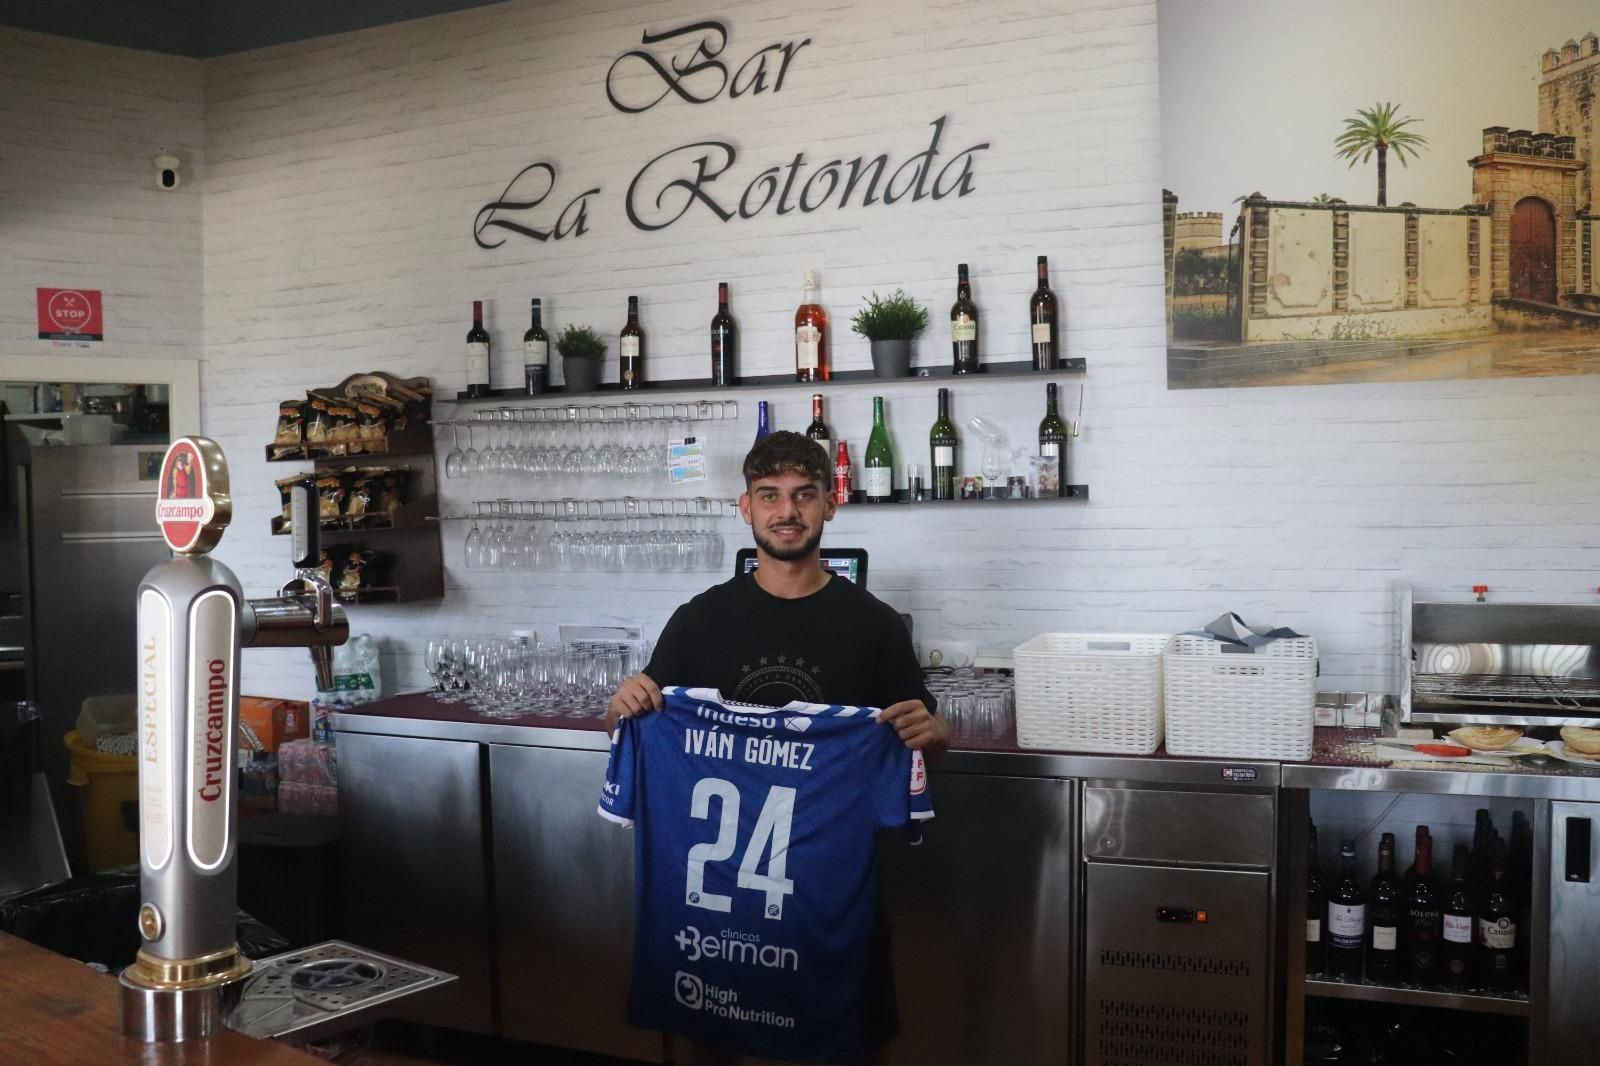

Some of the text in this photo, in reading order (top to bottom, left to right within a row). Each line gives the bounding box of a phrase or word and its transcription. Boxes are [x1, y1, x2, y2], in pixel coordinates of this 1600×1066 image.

[605, 20, 811, 114] Bar
[473, 115, 990, 249] La Rotonda
[55, 310, 85, 318] STOP
[144, 636, 157, 763] ESPECIAL
[198, 659, 227, 802] Cruzcampo
[684, 725, 815, 771] IVÁN GÓMEZ
[685, 777, 797, 921] 24
[705, 983, 738, 1004] High
